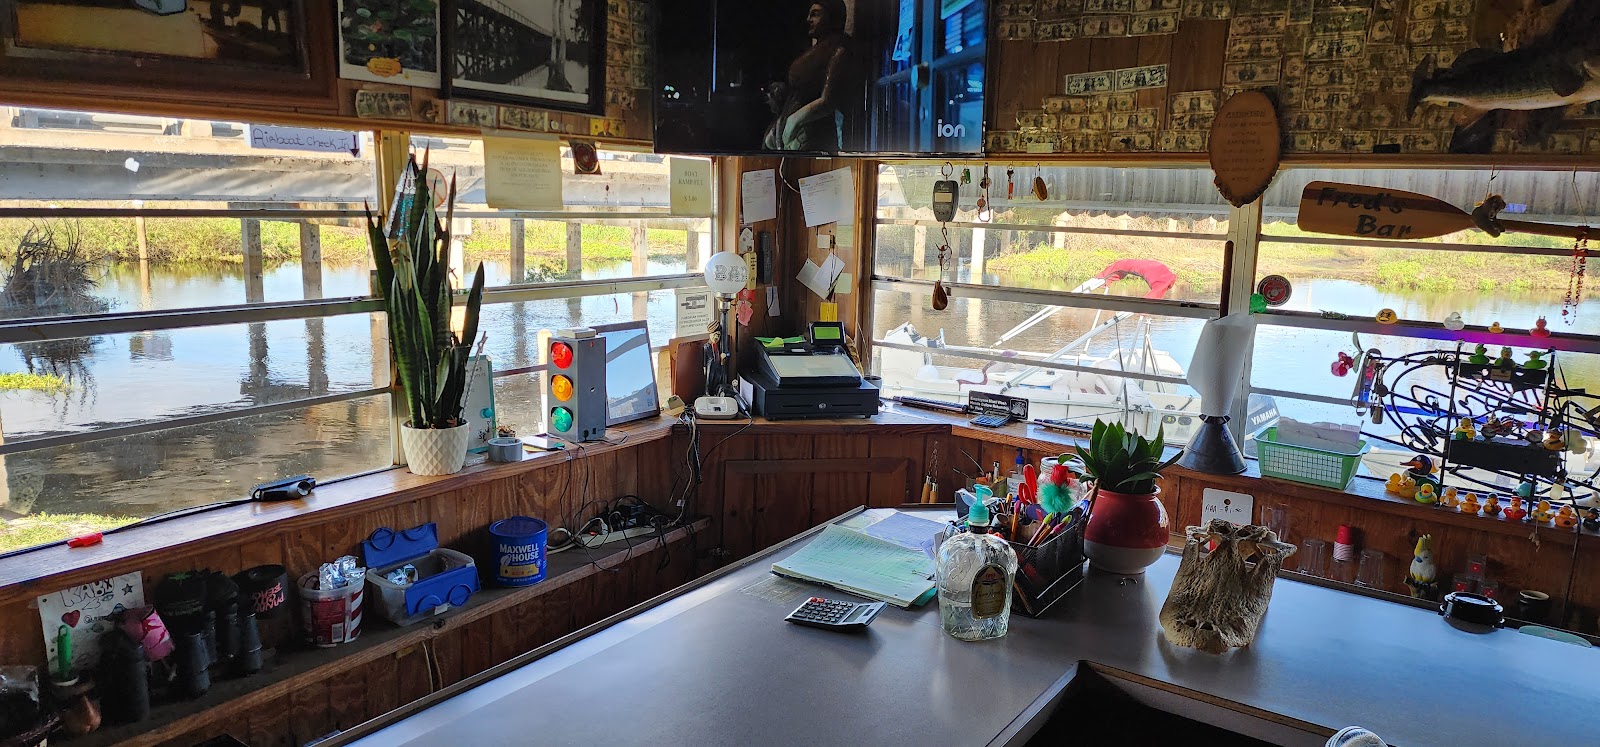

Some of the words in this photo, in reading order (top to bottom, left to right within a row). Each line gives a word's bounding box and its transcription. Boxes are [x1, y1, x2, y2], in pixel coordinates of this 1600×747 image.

[937, 118, 966, 138] ion
[252, 127, 305, 148] Airboat
[306, 135, 337, 150] Check
[1317, 187, 1403, 213] Fred's
[1354, 214, 1413, 238] Bar
[1251, 408, 1278, 425] YAMAHA
[500, 543, 539, 553] MAXWELL
[512, 551, 539, 561] HOUSE
